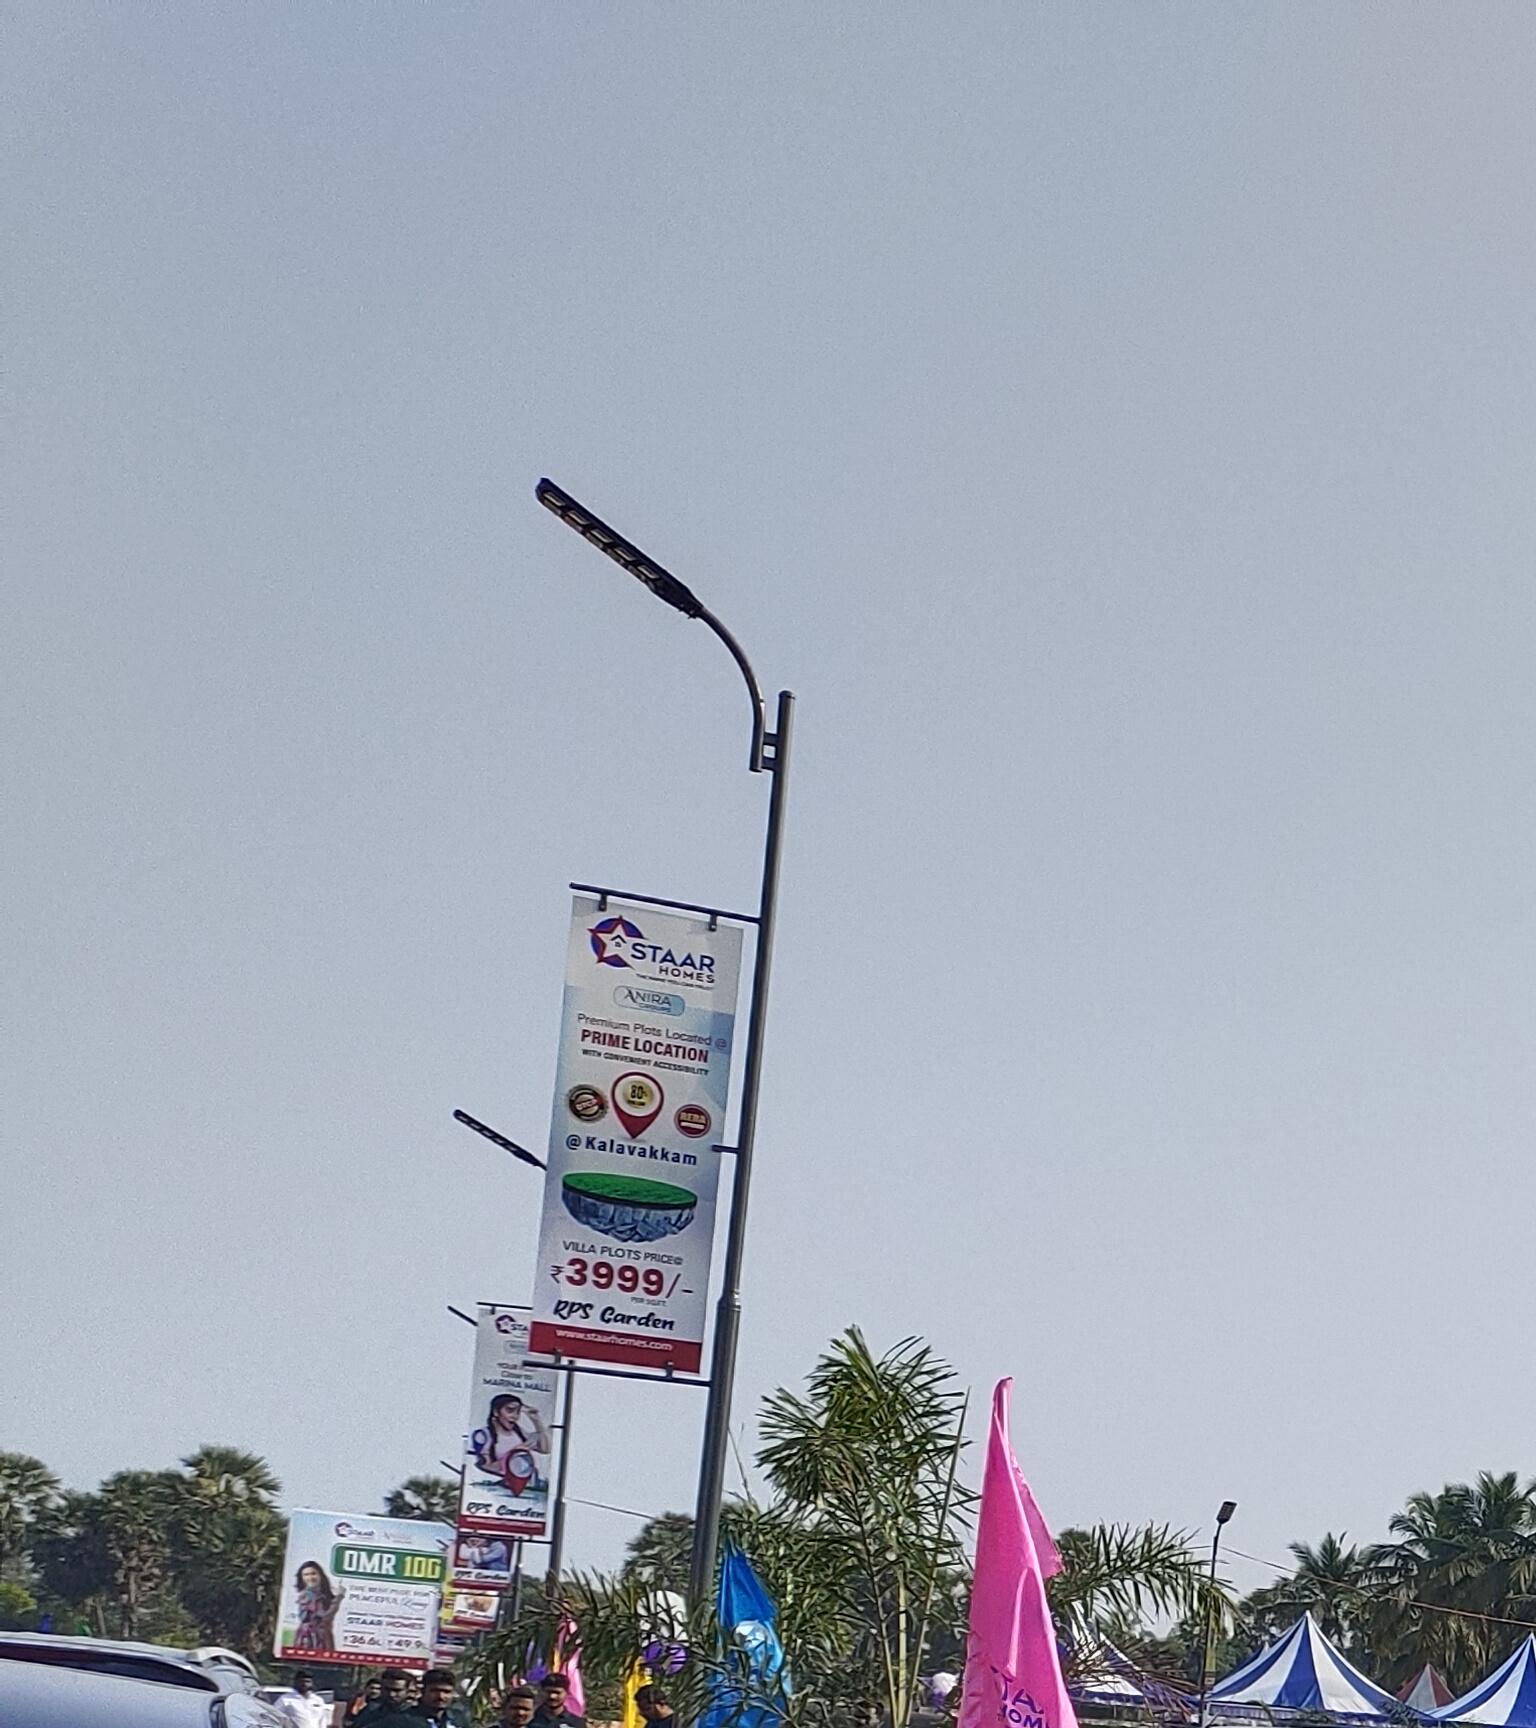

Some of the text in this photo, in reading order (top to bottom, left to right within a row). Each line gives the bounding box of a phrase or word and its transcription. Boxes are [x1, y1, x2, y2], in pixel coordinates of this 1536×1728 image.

[631, 943, 715, 973] STAAR
[658, 965, 716, 984] HOMES
[623, 988, 672, 1007] ANIRA
[577, 1012, 630, 1031] Premium
[633, 1023, 662, 1036] Plots
[665, 1028, 712, 1046] Located
[580, 1028, 709, 1063] PRIME LOCATION
[562, 1240, 597, 1254] VILLA
[600, 1246, 642, 1261] PLOTS
[553, 1299, 675, 1331] RPS Garden
[555, 1328, 674, 1351] www.staarhomes.com
[343, 1550, 397, 1575] OMR
